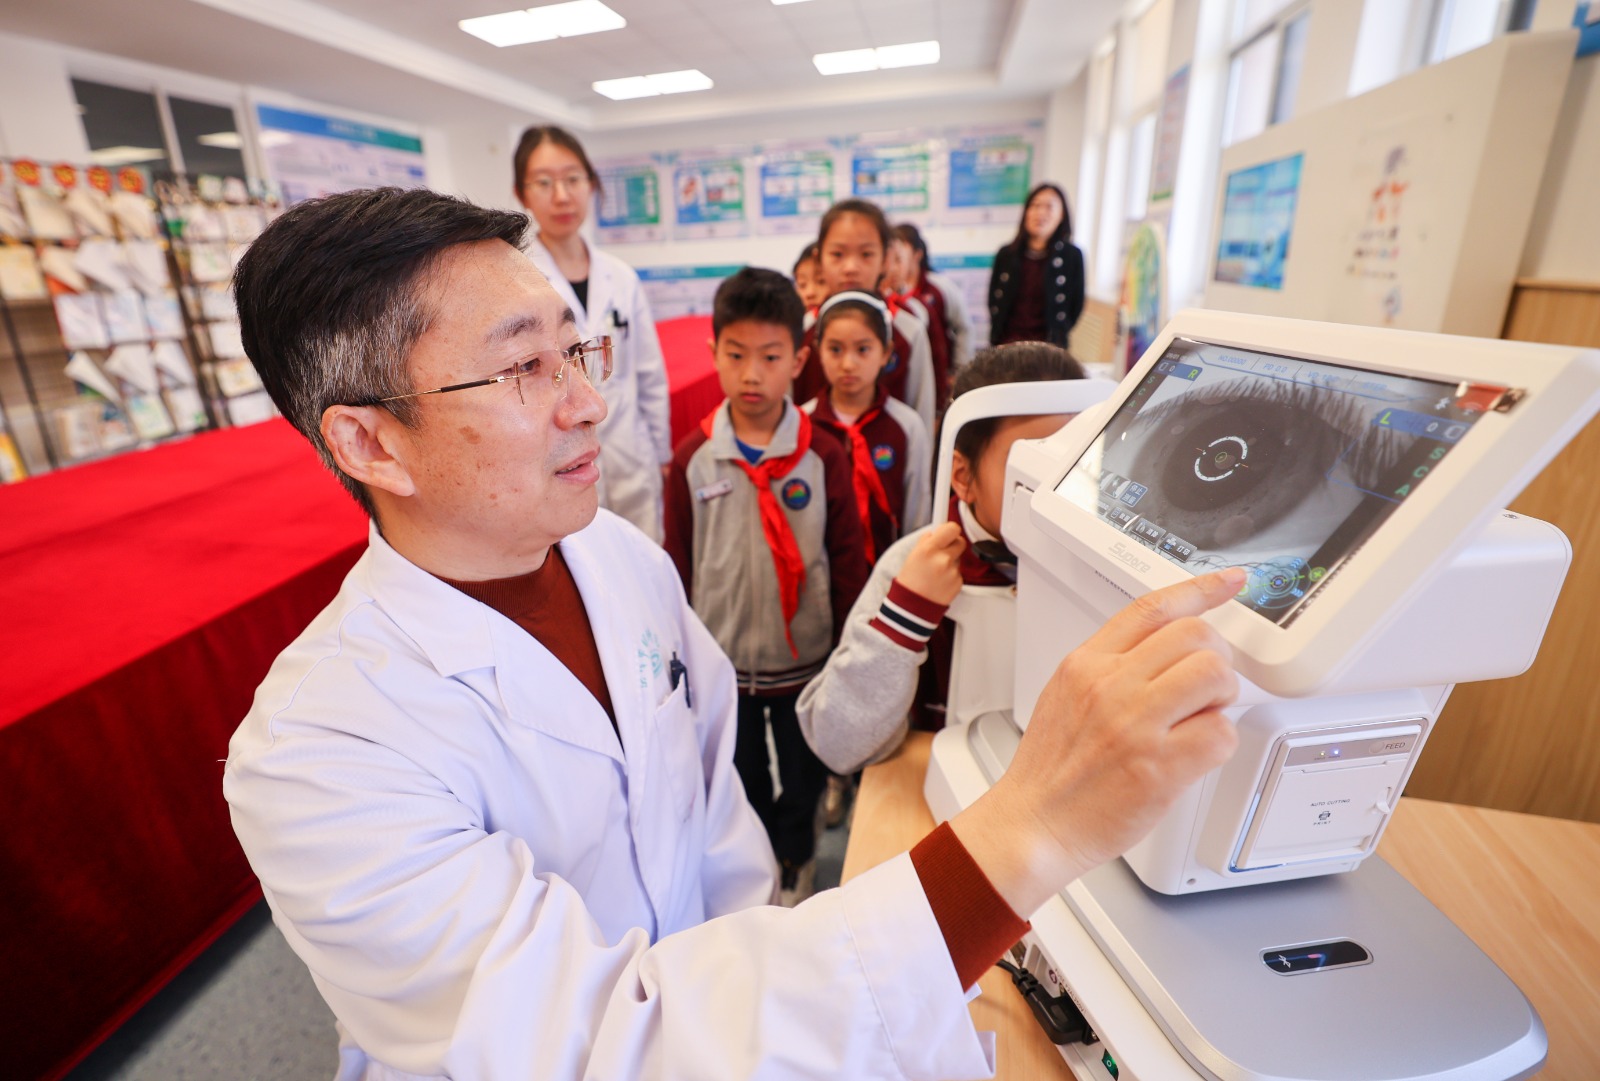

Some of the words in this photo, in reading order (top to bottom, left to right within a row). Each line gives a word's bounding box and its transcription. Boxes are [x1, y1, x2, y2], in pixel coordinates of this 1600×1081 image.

[1187, 368, 1199, 379] R
[1147, 375, 1156, 384] S
[1380, 411, 1391, 424] L
[1430, 447, 1445, 459] S
[1413, 466, 1428, 477] C
[1395, 484, 1409, 495] A
[1177, 546, 1190, 555] 打印
[1385, 742, 1406, 750] FEED
